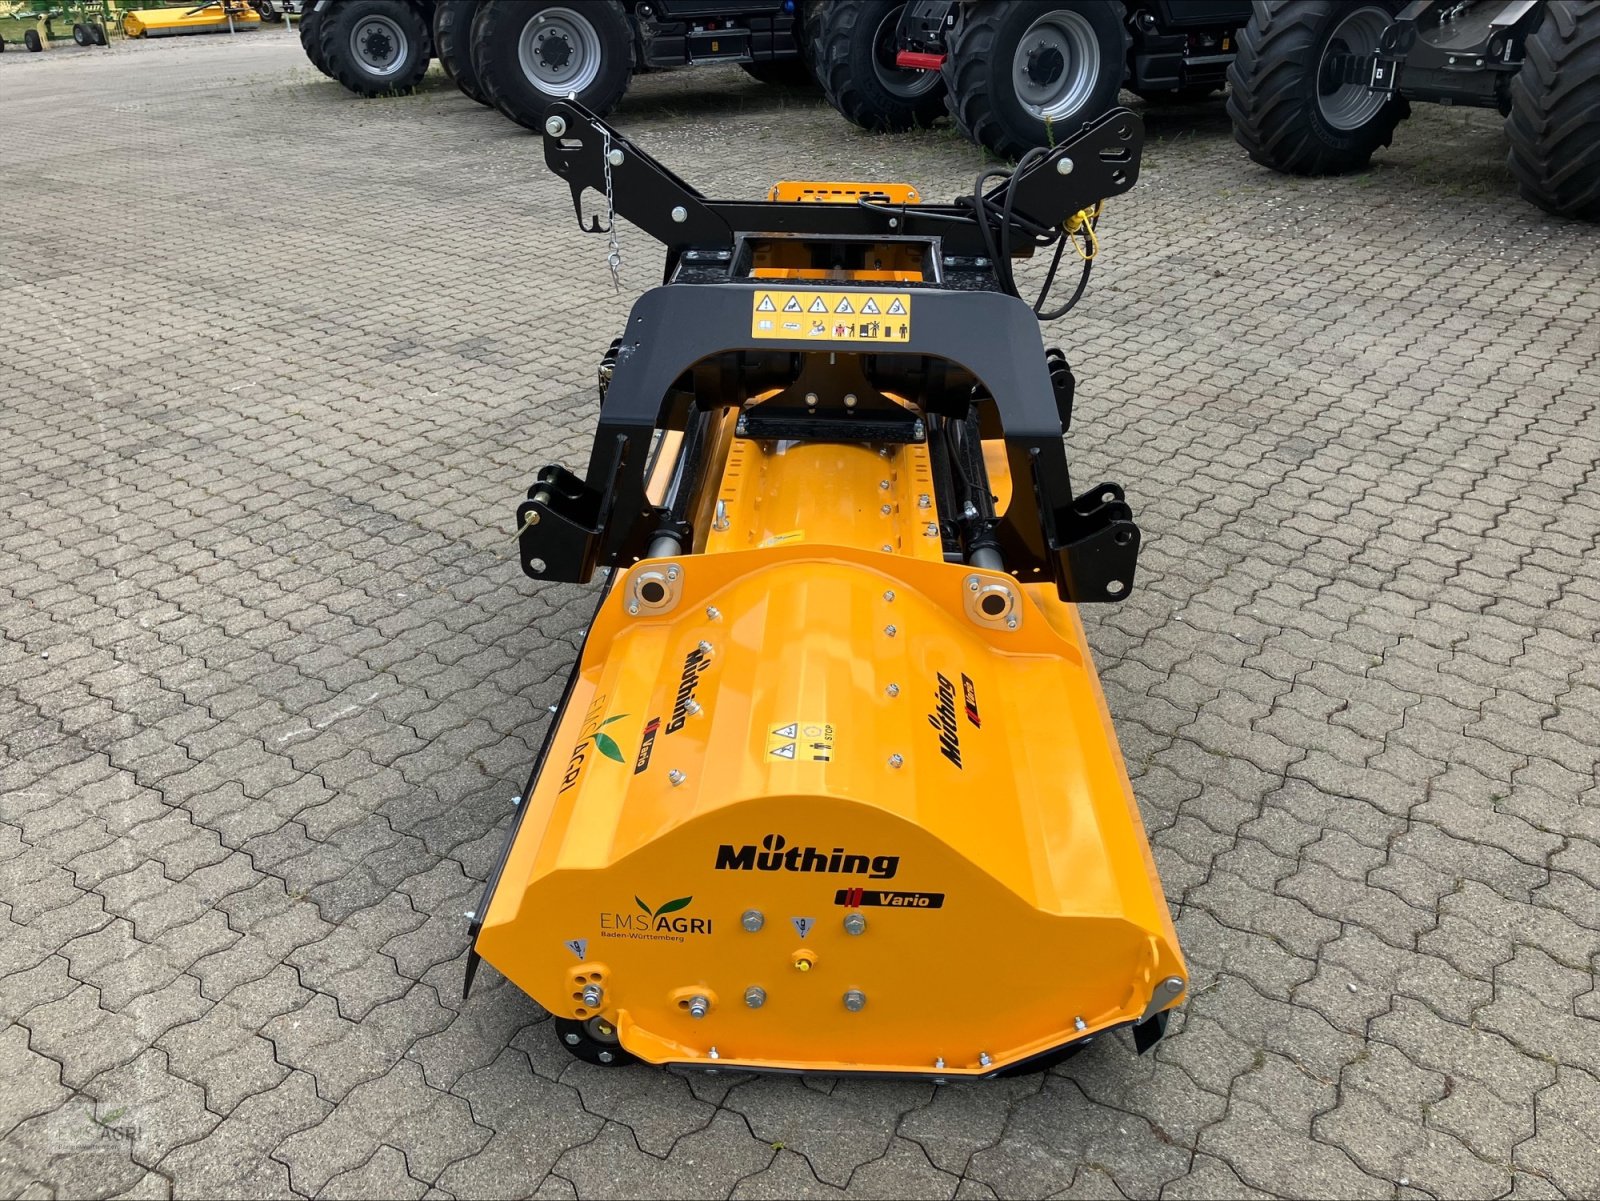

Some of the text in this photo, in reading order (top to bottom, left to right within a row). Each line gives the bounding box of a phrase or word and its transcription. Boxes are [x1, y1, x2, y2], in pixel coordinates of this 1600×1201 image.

[928, 672, 962, 769] Müthing
[825, 724, 833, 741] STOP
[637, 738, 654, 767] Vario
[715, 833, 900, 879] Müthing
[879, 892, 930, 907] Vario
[656, 916, 712, 935] AGRI
[600, 931, 685, 942] Baden-Württemberg
